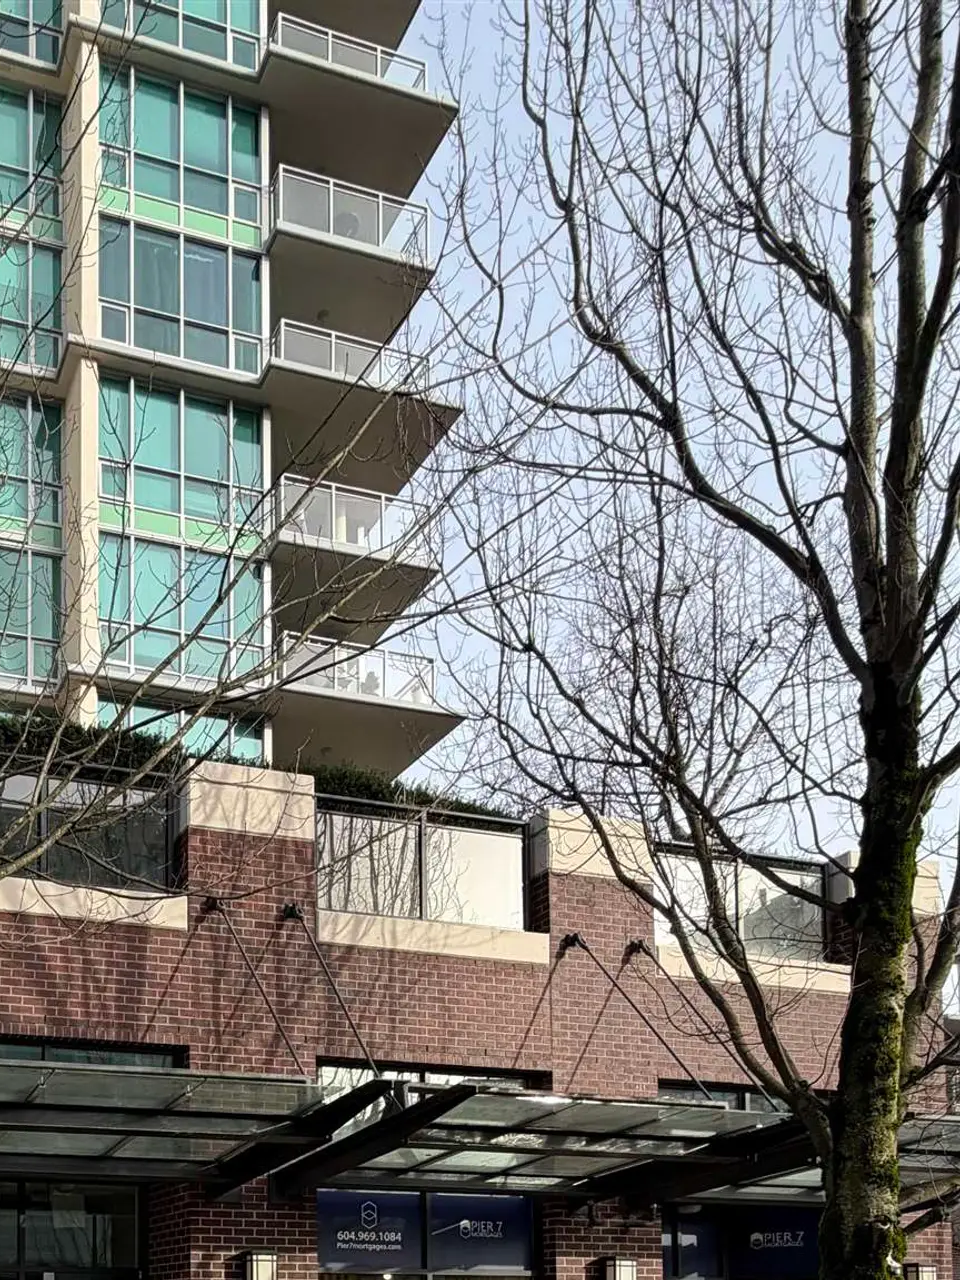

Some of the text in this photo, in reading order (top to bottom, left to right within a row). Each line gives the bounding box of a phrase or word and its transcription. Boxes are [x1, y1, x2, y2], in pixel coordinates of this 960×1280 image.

[471, 1221, 503, 1233] PIER 7
[337, 1231, 402, 1242] 604.969.1084
[764, 1232, 793, 1246] PIER
[796, 1231, 805, 1243] 7
